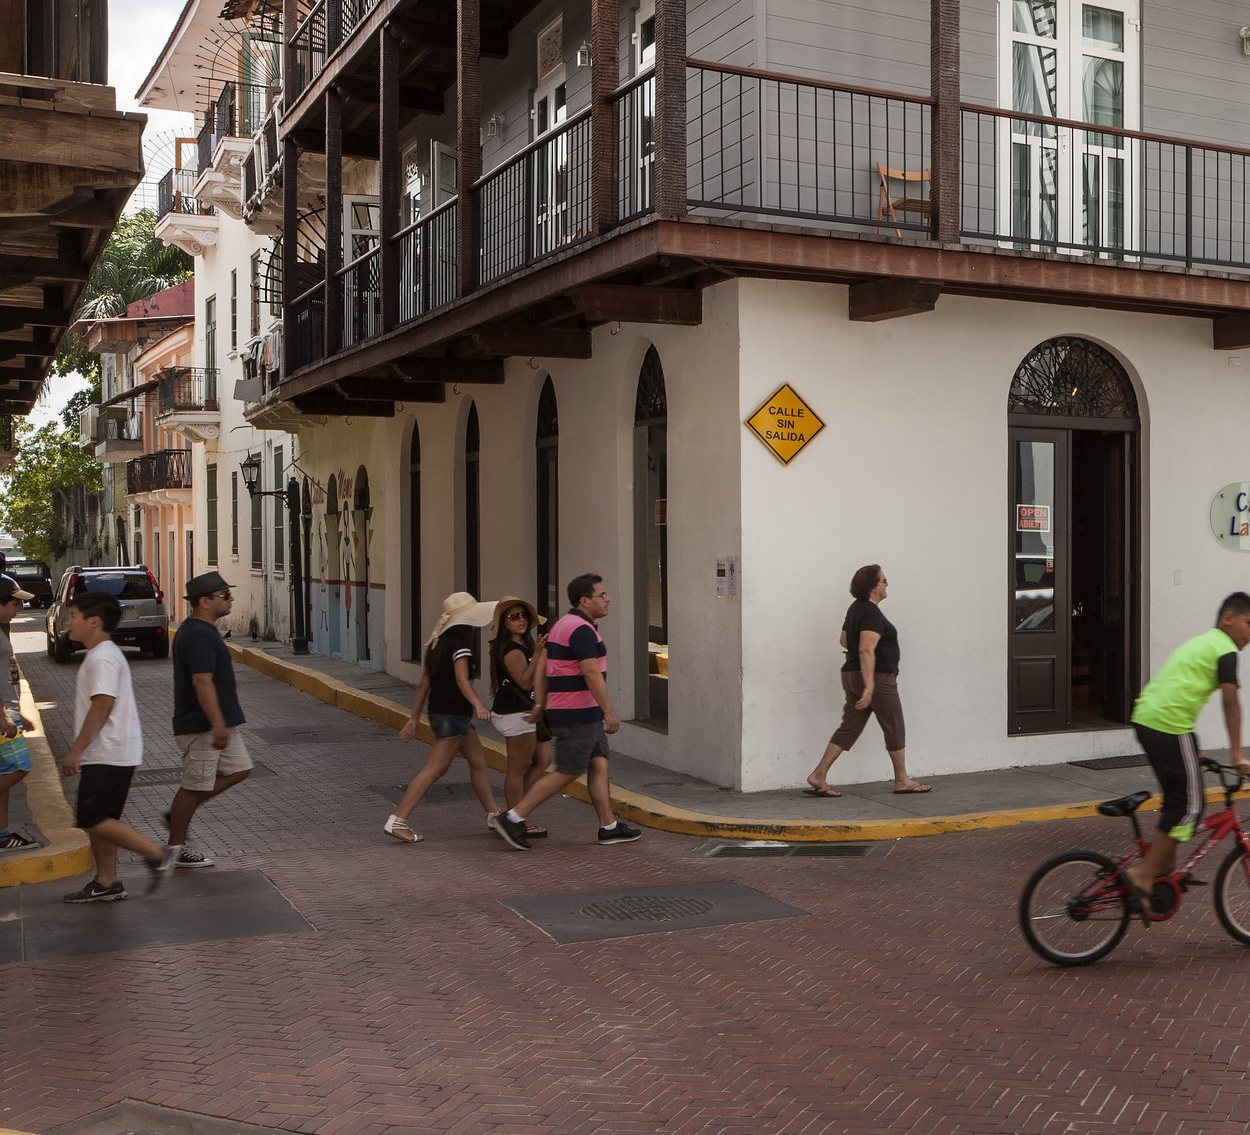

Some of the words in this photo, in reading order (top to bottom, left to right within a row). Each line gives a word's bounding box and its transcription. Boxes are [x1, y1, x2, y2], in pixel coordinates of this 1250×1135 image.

[768, 406, 805, 418] CALLE
[777, 419, 795, 429] SIN
[765, 430, 806, 442] SALIDA
[1020, 508, 1047, 517] OPEN
[1019, 519, 1048, 529] ABIERTO
